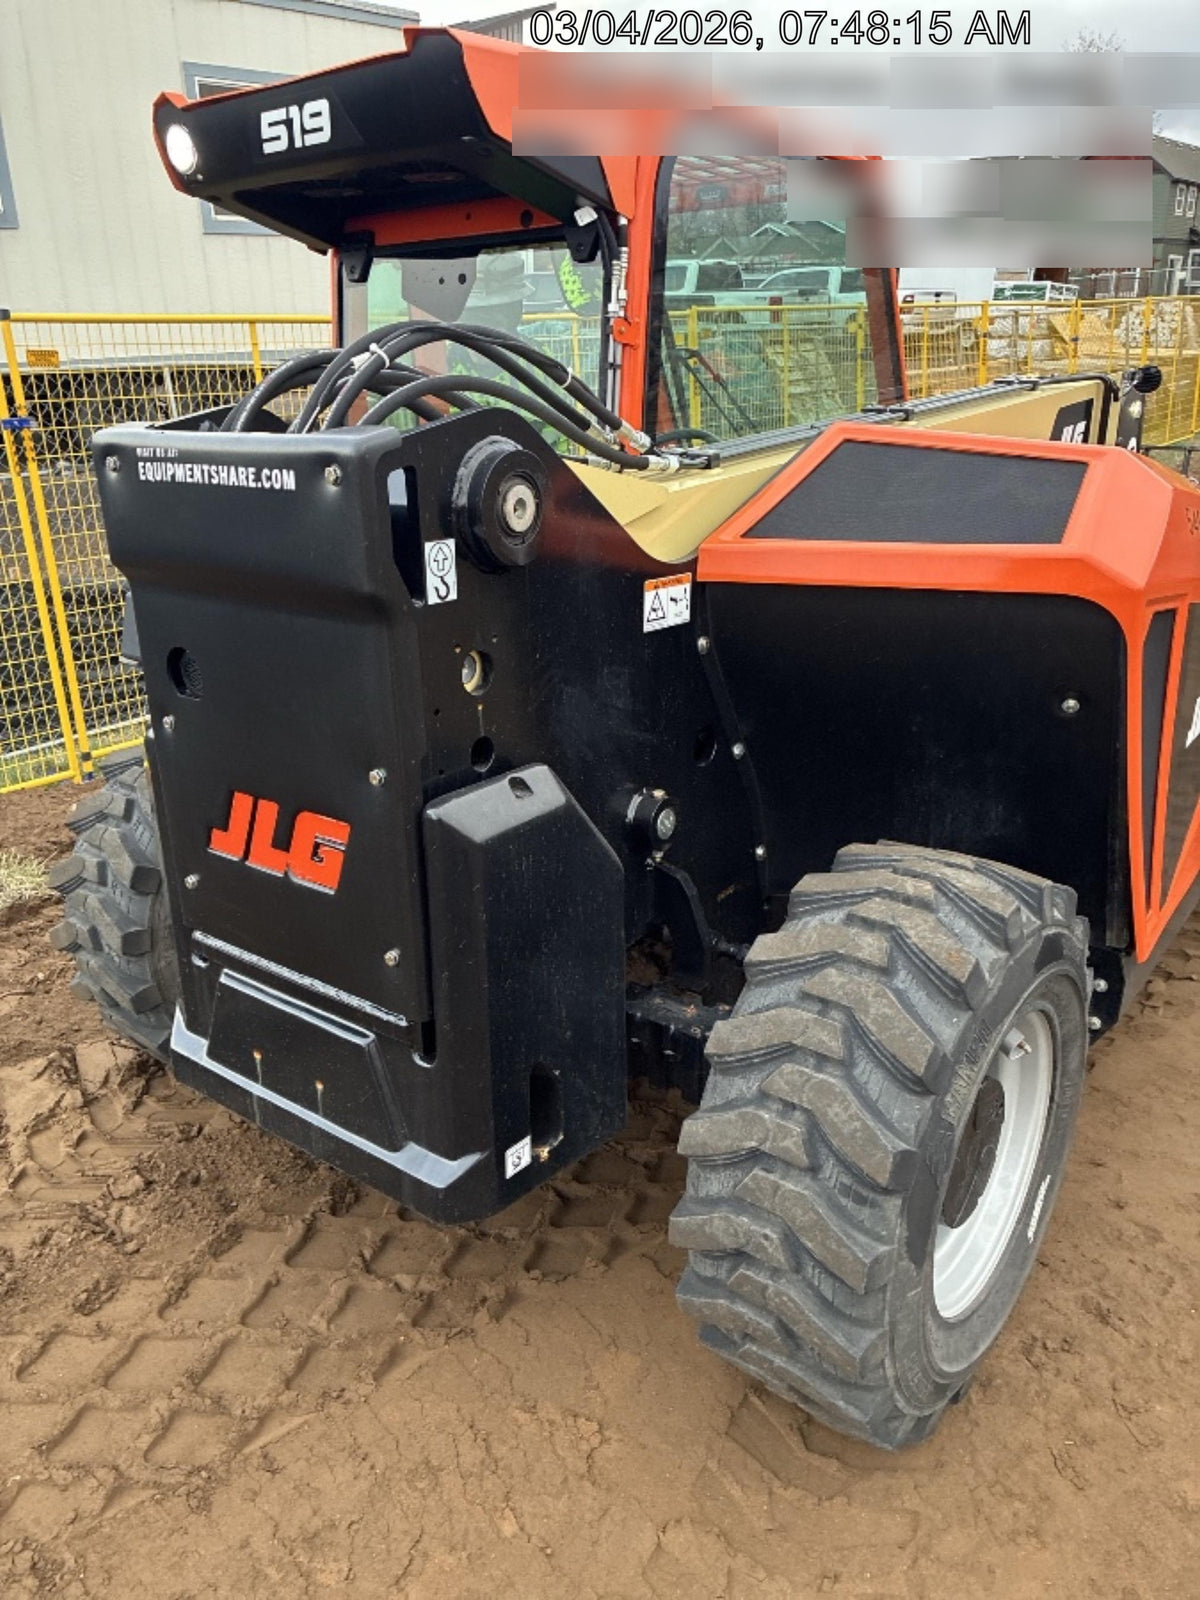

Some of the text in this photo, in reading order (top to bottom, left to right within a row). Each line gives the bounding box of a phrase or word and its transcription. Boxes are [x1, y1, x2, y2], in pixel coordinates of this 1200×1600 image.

[260, 98, 332, 155] 519
[137, 461, 297, 491] EQUIPMENTSHARE.COM
[207, 791, 350, 895] JLG
